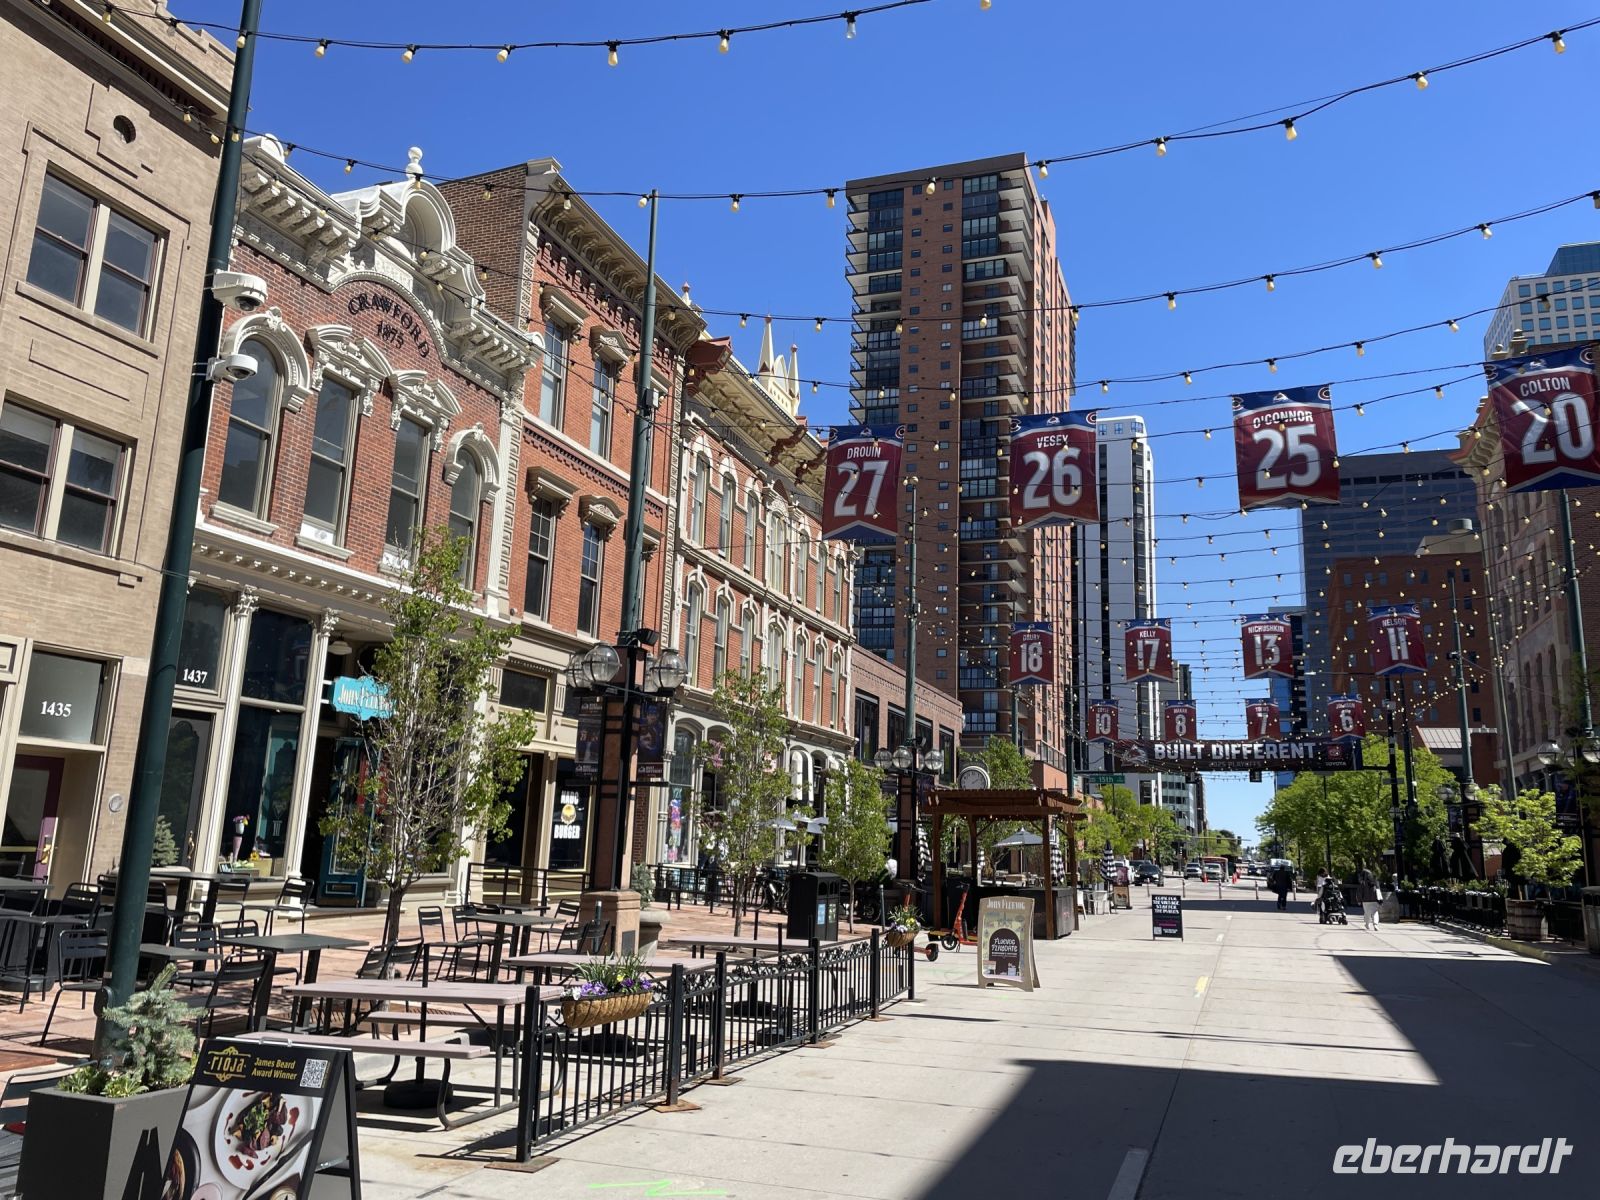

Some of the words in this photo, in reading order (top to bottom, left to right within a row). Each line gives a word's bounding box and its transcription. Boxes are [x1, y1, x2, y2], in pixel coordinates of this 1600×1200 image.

[348, 293, 429, 358] CRAWFORD
[1520, 377, 1571, 397] COLTON
[1253, 411, 1313, 428] O'CONNOR
[1512, 392, 1594, 465] 20
[1037, 434, 1068, 449] VESEY
[846, 446, 881, 459] DROUIN
[1252, 424, 1321, 490] 25
[834, 460, 889, 517] 27
[1023, 447, 1082, 509] 26
[1248, 625, 1284, 633] NICHUSHKIN
[1382, 618, 1407, 627] NELSON
[1139, 630, 1156, 638] KELLY
[1387, 627, 1409, 661] 11
[1020, 643, 1043, 673] 18
[1137, 639, 1160, 670] 17
[1254, 634, 1280, 667] 13
[183, 669, 208, 684] 1437
[40, 701, 72, 717] 1435
[1095, 713, 1111, 735] 10
[1175, 714, 1187, 736] 8
[1257, 712, 1269, 735] 7
[1340, 709, 1354, 732] 6
[1154, 743, 1205, 760] BUILT
[1211, 742, 1316, 760] DIFFERENT
[554, 825, 580, 839] BURGER
[252, 1067, 272, 1077] Award
[273, 1068, 298, 1080] Winner
[254, 1057, 276, 1068] James
[276, 1059, 296, 1069] Beard
